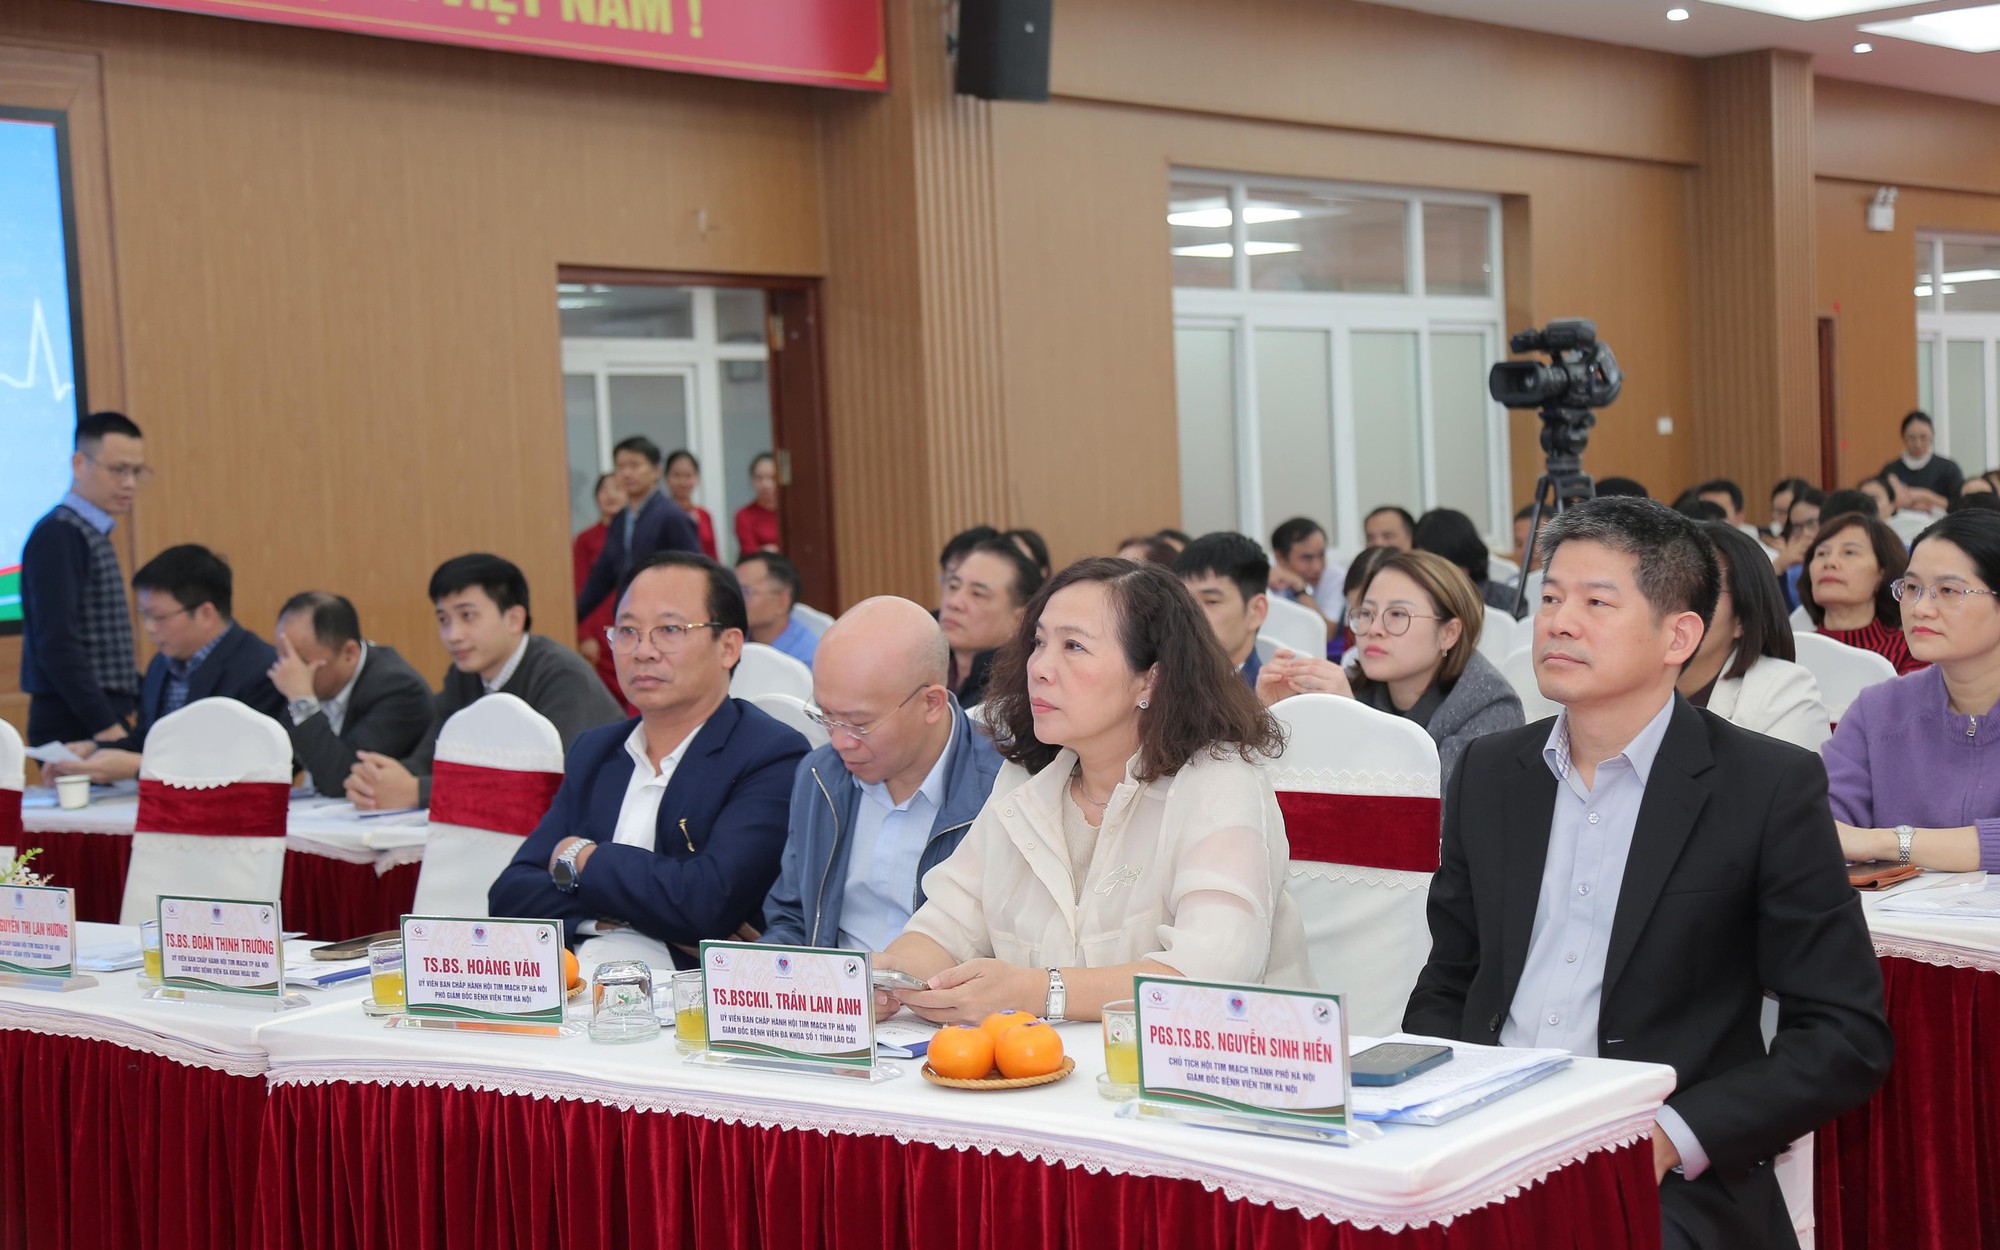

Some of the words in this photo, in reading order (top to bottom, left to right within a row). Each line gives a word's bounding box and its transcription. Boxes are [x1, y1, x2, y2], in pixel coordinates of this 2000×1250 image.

[21, 921, 31, 937] THỊ
[33, 921, 45, 936] LAN
[165, 933, 190, 948] TS.BS.
[192, 933, 213, 950] ĐOÀN
[216, 937, 239, 955] THỊNH
[241, 936, 274, 954] TRƯỜNG
[423, 957, 463, 974] TS.BS.
[468, 957, 511, 975] HOÀNG
[514, 959, 541, 977] VĂN
[427, 979, 439, 988] VIÊN
[440, 980, 450, 988] BAN
[483, 982, 492, 991] HỘI
[505, 984, 520, 993] MẠCH
[538, 985, 547, 995] NỘI
[474, 993, 488, 1002] BỆNH
[489, 993, 501, 1003] VIỆN
[522, 995, 532, 1004] NỘI
[713, 988, 773, 1009] TS.BSCKII.
[776, 988, 807, 1011] TRẦN
[810, 995, 833, 1013] LAN
[836, 998, 862, 1016] ANH
[728, 1014, 741, 1023] VIÊN
[742, 1015, 754, 1023] BAN
[771, 1017, 787, 1026] HÀNH
[788, 1018, 798, 1027] HỘI
[811, 1021, 827, 1031] MẠCH
[828, 1022, 836, 1030] TP
[846, 1023, 856, 1033] NỘI
[738, 1026, 749, 1035] ĐỐC
[750, 1027, 765, 1037] BỆNH
[766, 1028, 779, 1038] VIỆN
[790, 1032, 805, 1040] KHOA
[806, 1031, 813, 1040] SỐ
[846, 1036, 856, 1044] CAI
[1150, 1025, 1215, 1050] PGS.TS.BS.
[1218, 1029, 1266, 1056] NGUYỄN
[1270, 1038, 1299, 1060] SINH
[1303, 1037, 1332, 1064] HIỂN
[1184, 1058, 1199, 1070] TỊCH
[1201, 1059, 1213, 1071] HỘI
[1214, 1062, 1227, 1072] TIM
[1228, 1064, 1249, 1076] MẠCH
[1250, 1065, 1274, 1077] THÀNH
[1291, 1070, 1301, 1081] HÀ
[1302, 1071, 1316, 1083] NỘI
[1206, 1073, 1220, 1084] ĐỐC
[1221, 1075, 1240, 1087] BỆNH
[1242, 1077, 1258, 1089] VIỆN
[1259, 1080, 1273, 1090] TIM
[1274, 1081, 1284, 1092] HÀ
[1285, 1083, 1298, 1095] NỘI
